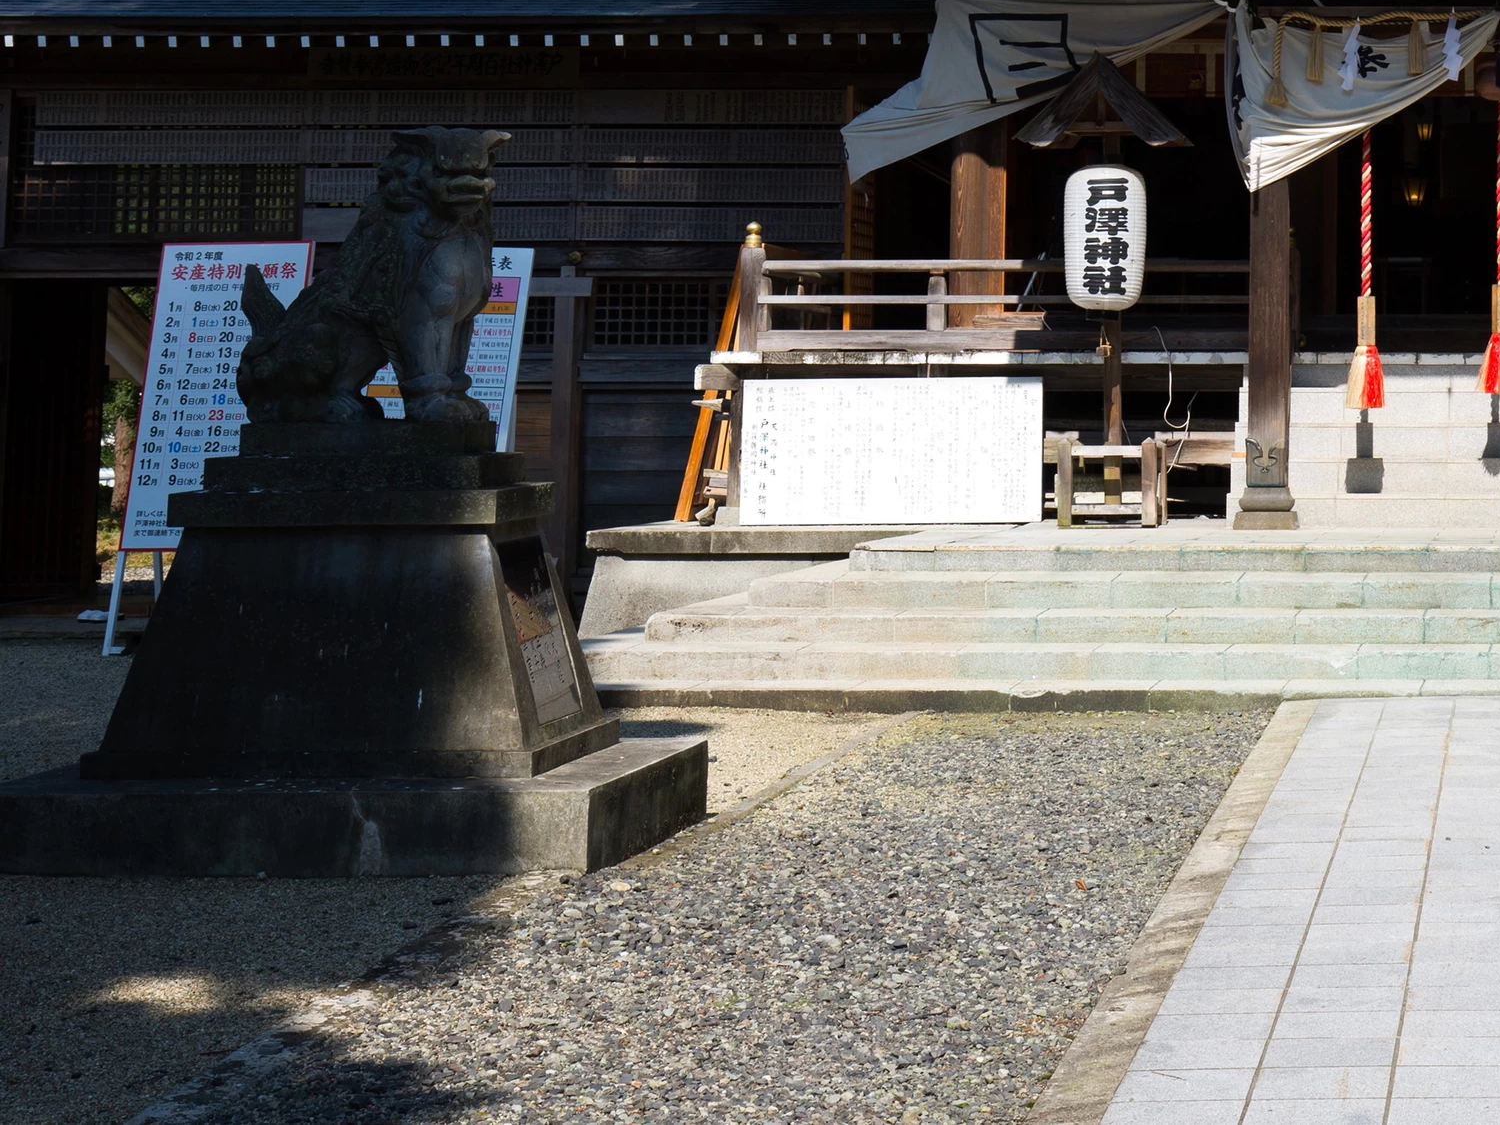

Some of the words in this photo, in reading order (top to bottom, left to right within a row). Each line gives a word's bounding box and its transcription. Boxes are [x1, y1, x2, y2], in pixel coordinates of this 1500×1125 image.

[1082, 177, 1129, 295] 戸澤神社
[171, 262, 298, 281] 安産特別願祭
[169, 301, 182, 312] 1月
[165, 317, 180, 327] 2月
[163, 332, 178, 343] 3月
[161, 348, 175, 359] 4月
[158, 363, 173, 375] 5月
[156, 379, 171, 390] 6月
[155, 395, 169, 405] 7月
[152, 410, 167, 421] 8月
[150, 426, 164, 437] 9月
[142, 442, 162, 453] 10月
[140, 459, 160, 470] 11月
[138, 475, 157, 486] 12月
